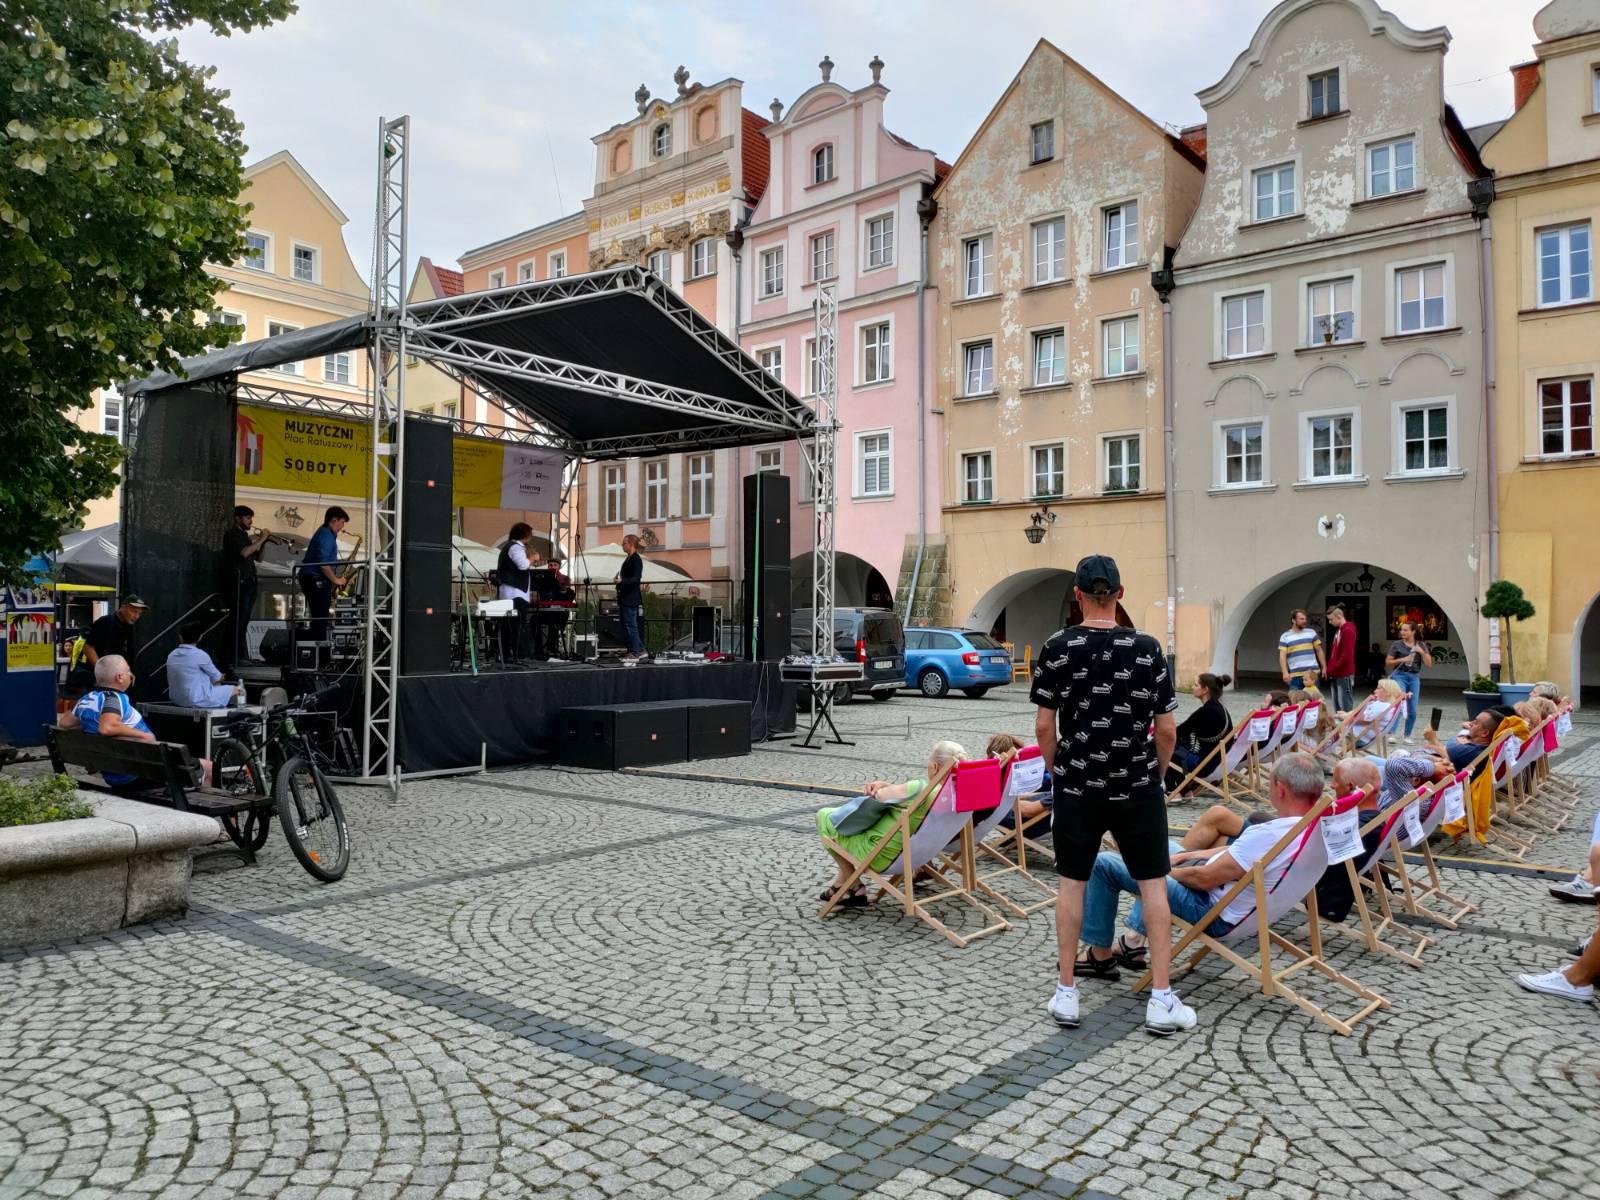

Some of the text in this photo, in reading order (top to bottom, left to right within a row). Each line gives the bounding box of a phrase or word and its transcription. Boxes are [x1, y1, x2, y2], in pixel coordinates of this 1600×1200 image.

[285, 419, 354, 440] MUZYCZNI
[284, 432, 305, 444] Plac
[307, 436, 354, 450] Ratuszowy
[284, 457, 348, 476] SOBOTY
[1334, 582, 1372, 594] FOL
